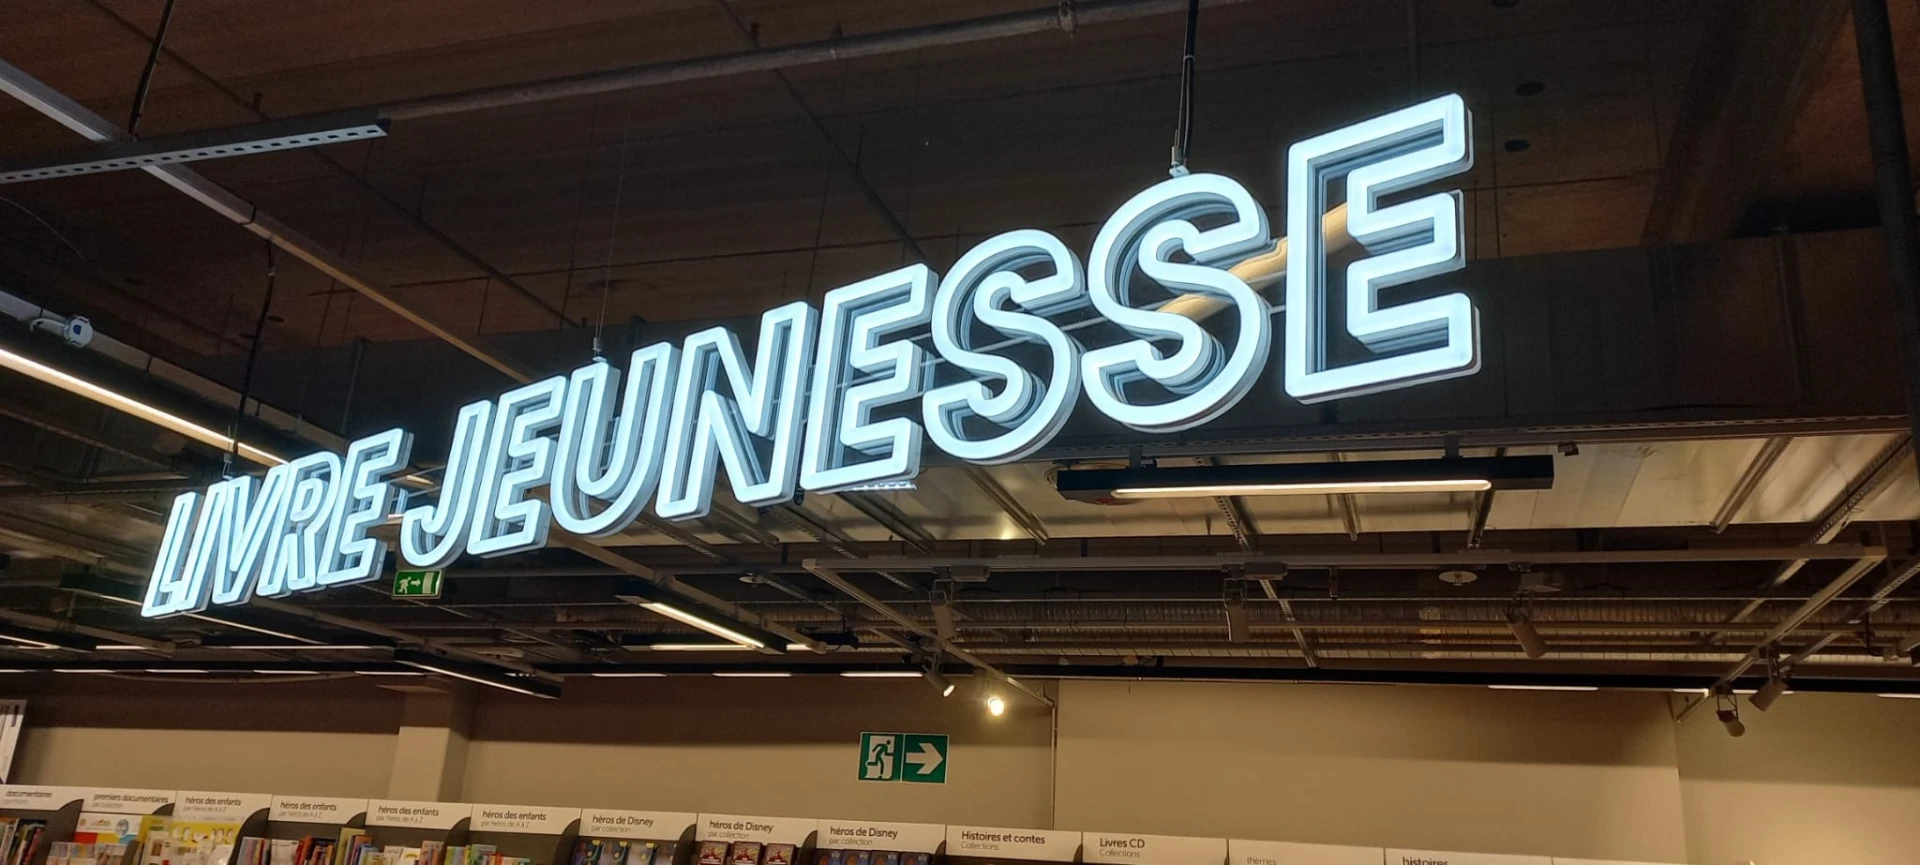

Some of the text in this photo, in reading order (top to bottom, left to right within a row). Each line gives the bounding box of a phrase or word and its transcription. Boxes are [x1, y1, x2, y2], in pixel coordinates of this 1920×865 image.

[141, 92, 1482, 618] LIVRE JEUNESSE
[93, 794, 168, 804] premiers documentaires
[185, 797, 242, 806] héros des enfants
[280, 802, 338, 812] héros des enfants
[378, 806, 439, 816] héros des enfants
[482, 810, 546, 820] héros des enfants
[592, 814, 654, 827] héros de Disney
[709, 820, 774, 834] héros de Disney
[718, 830, 750, 839] collection
[830, 826, 898, 840] héros de Disney
[961, 830, 1045, 844] Histoires et contes
[828, 838, 872, 846] par collection
[960, 841, 1000, 850] Collections
[1100, 838, 1145, 848] Livres CD
[1100, 848, 1140, 858] Collections
[1402, 856, 1448, 865] histoires
